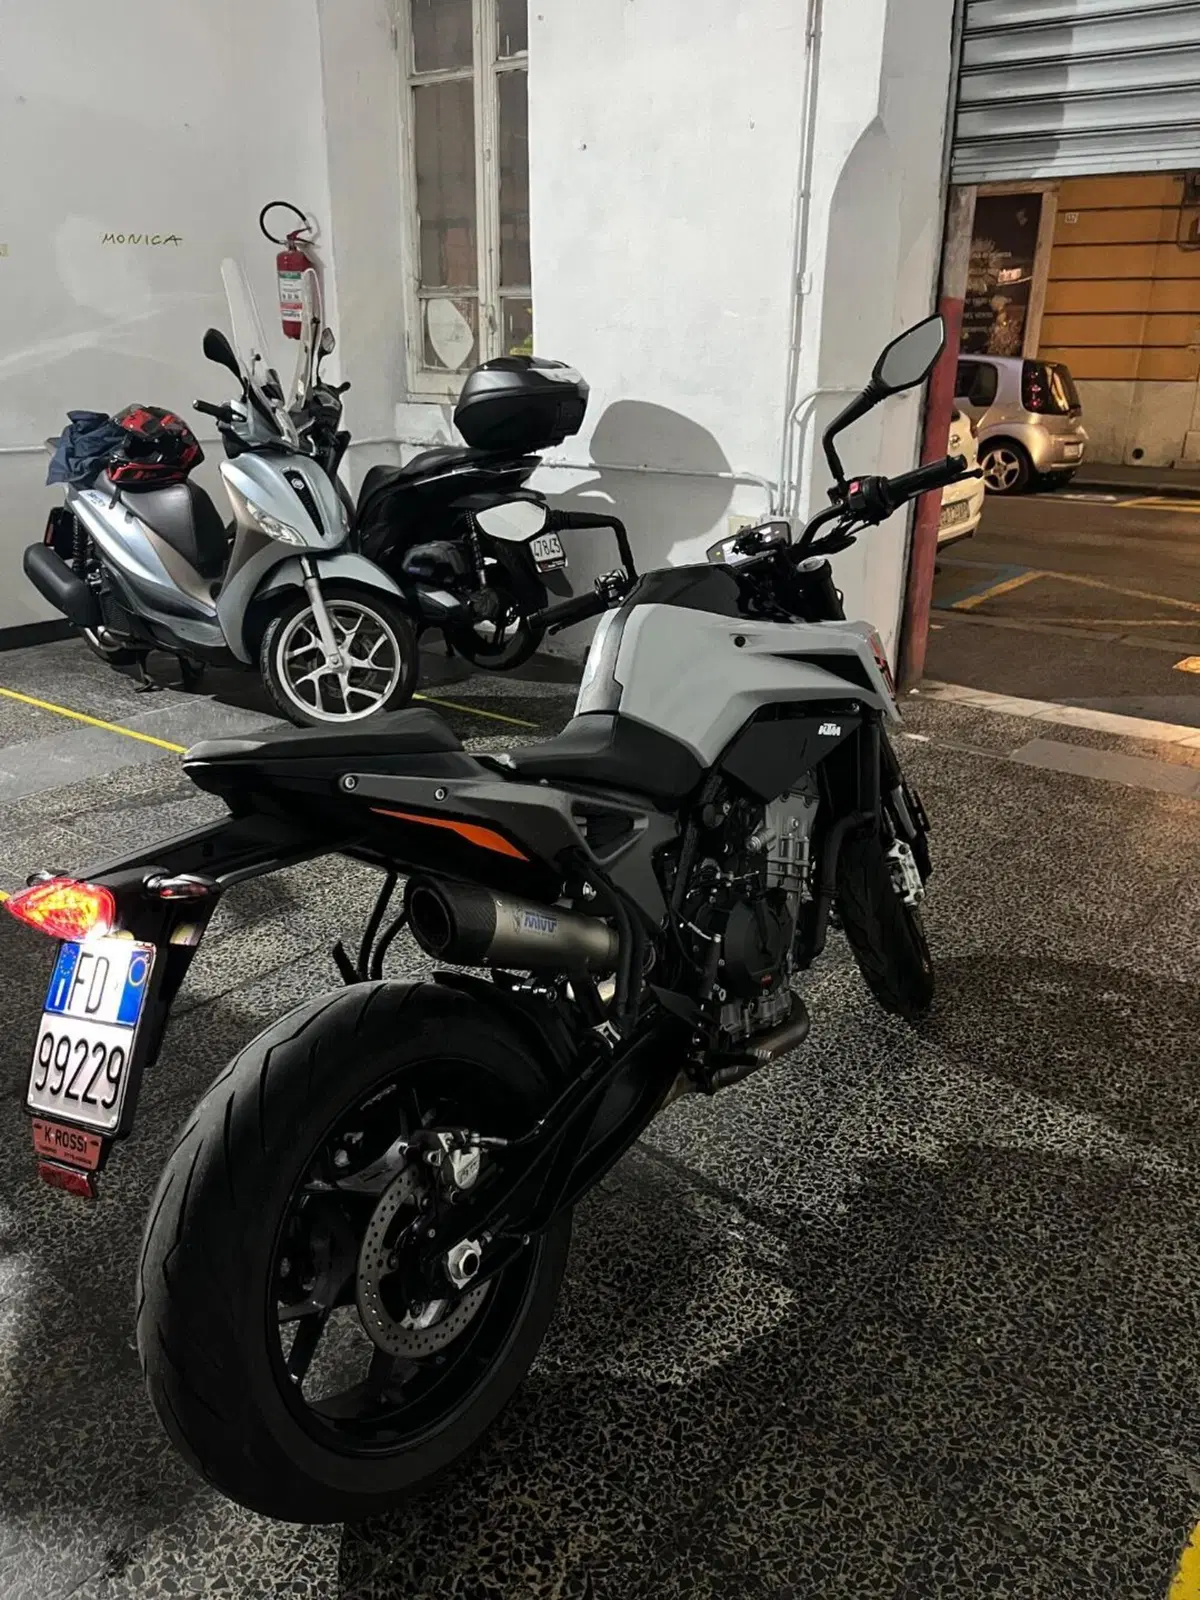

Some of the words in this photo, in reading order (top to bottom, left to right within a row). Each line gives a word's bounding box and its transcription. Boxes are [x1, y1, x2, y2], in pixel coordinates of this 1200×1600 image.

[102, 233, 183, 246] MONICA
[818, 722, 841, 736] KTM
[67, 951, 110, 1014] FD
[35, 1031, 125, 1109] 99229
